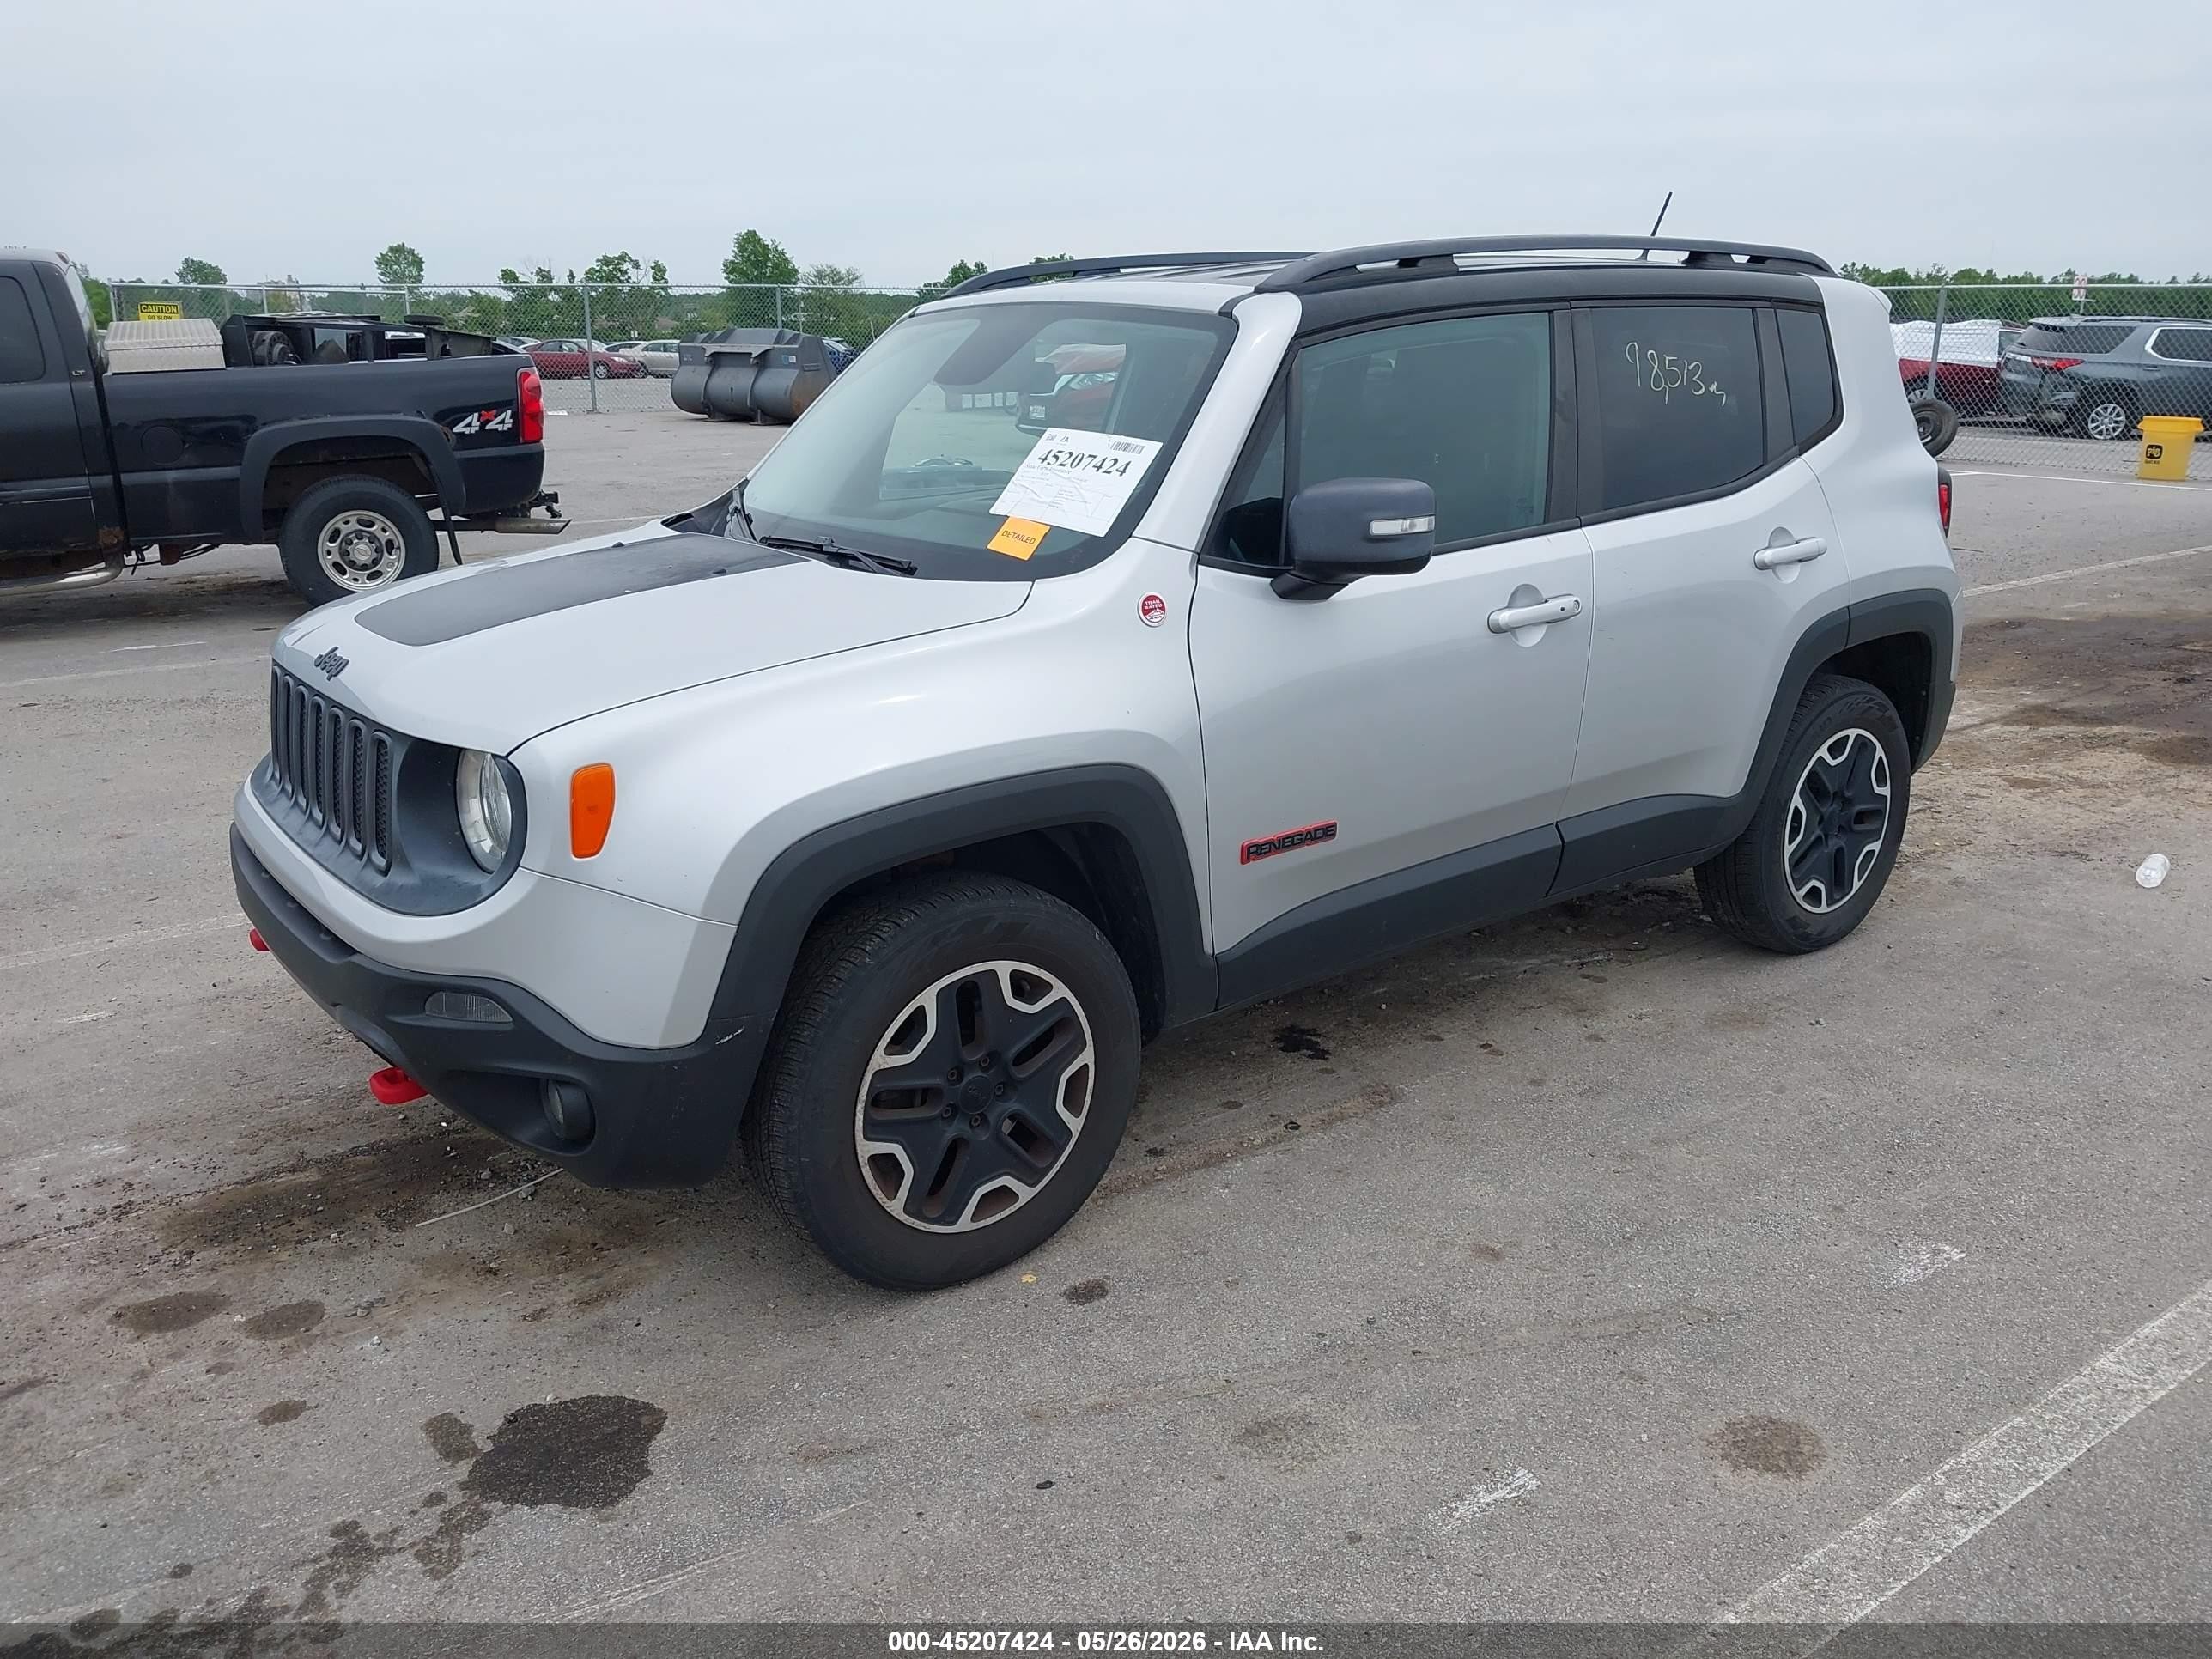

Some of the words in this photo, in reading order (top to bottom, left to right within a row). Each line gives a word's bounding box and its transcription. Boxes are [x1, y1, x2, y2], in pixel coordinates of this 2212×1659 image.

[141, 304, 178, 313] CAUTION
[1037, 448, 1133, 477] 45207424
[1001, 530, 1036, 544] DETAILED
[313, 646, 350, 682] Jeep
[1244, 823, 1338, 861] RENEGADE
